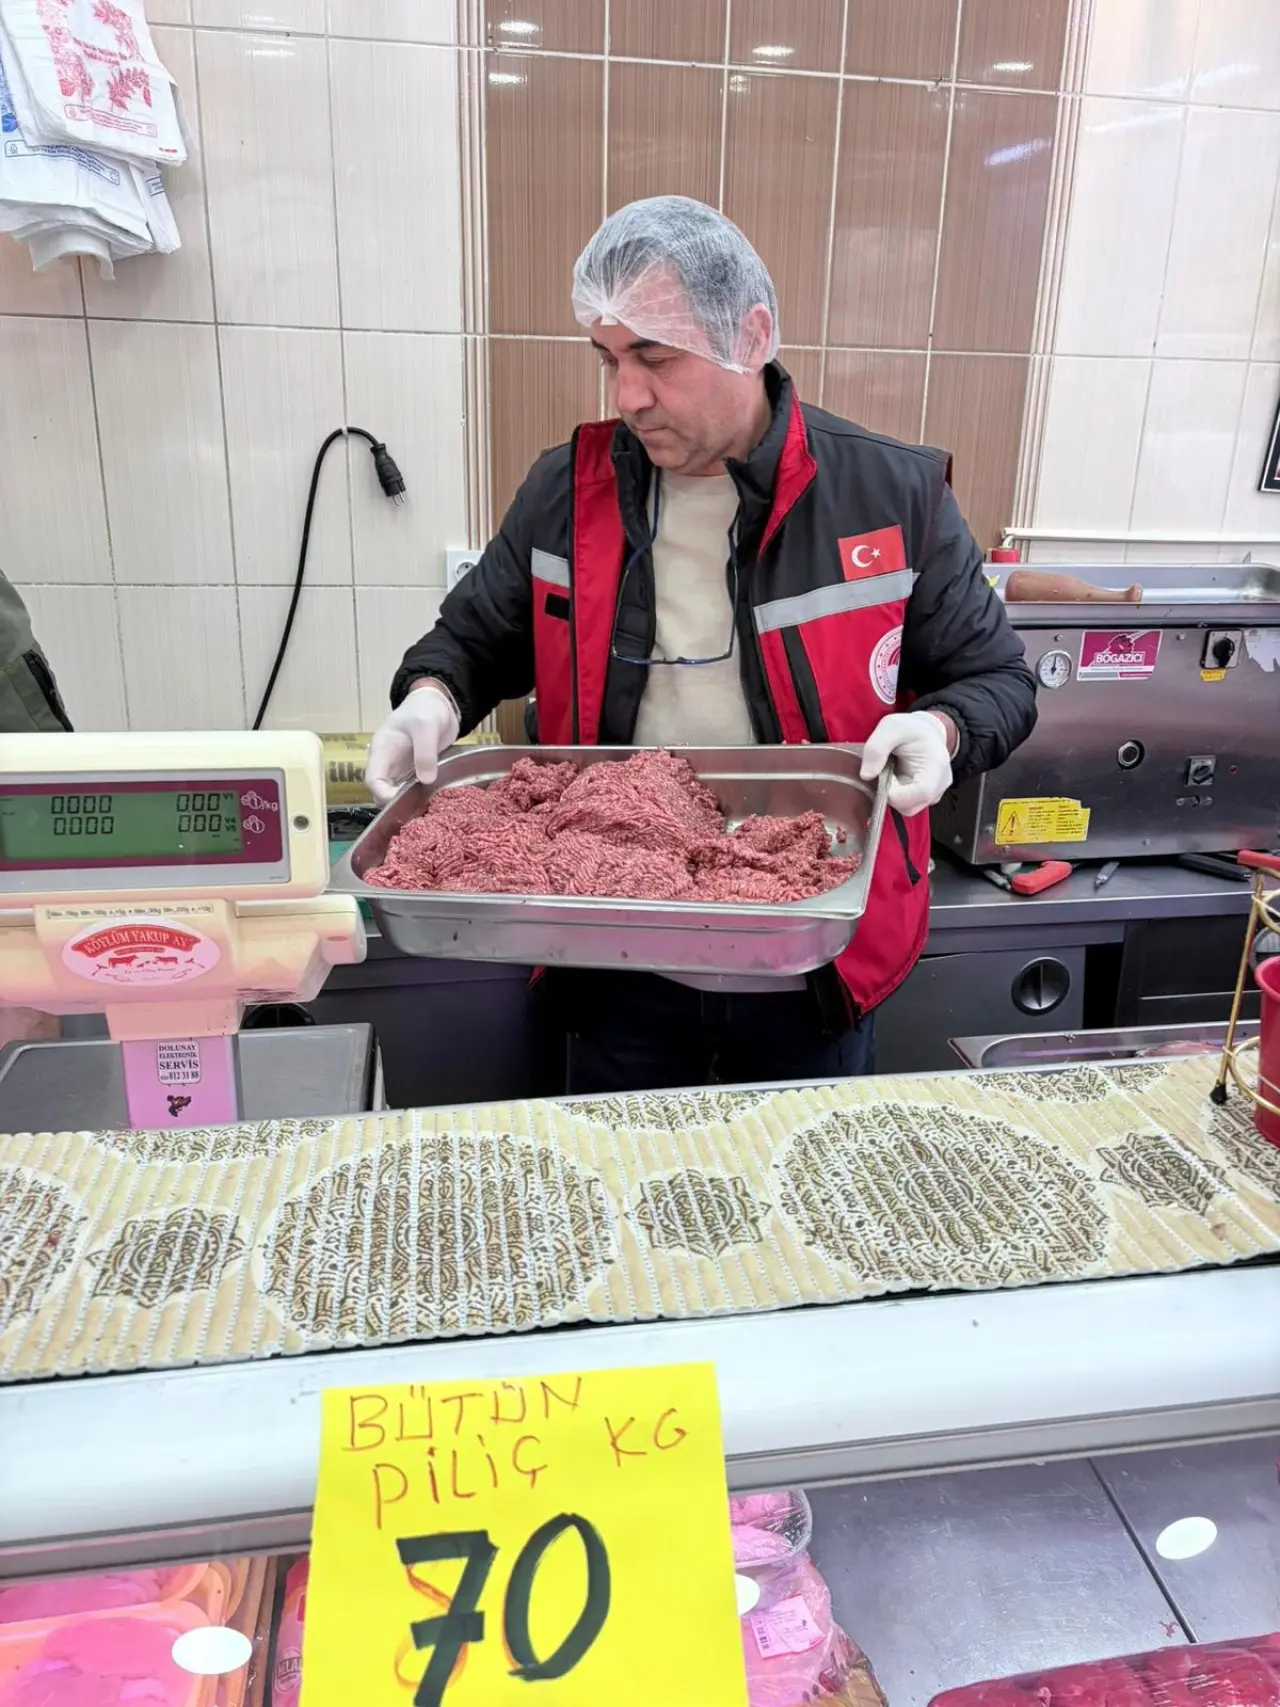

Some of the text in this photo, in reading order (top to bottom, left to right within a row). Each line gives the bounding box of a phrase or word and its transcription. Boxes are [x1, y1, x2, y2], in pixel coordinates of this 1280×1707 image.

[342, 1376, 582, 1451] BÜTÜN
[373, 1408, 689, 1530] PİLİÇ KG
[395, 1512, 611, 1707] 70
